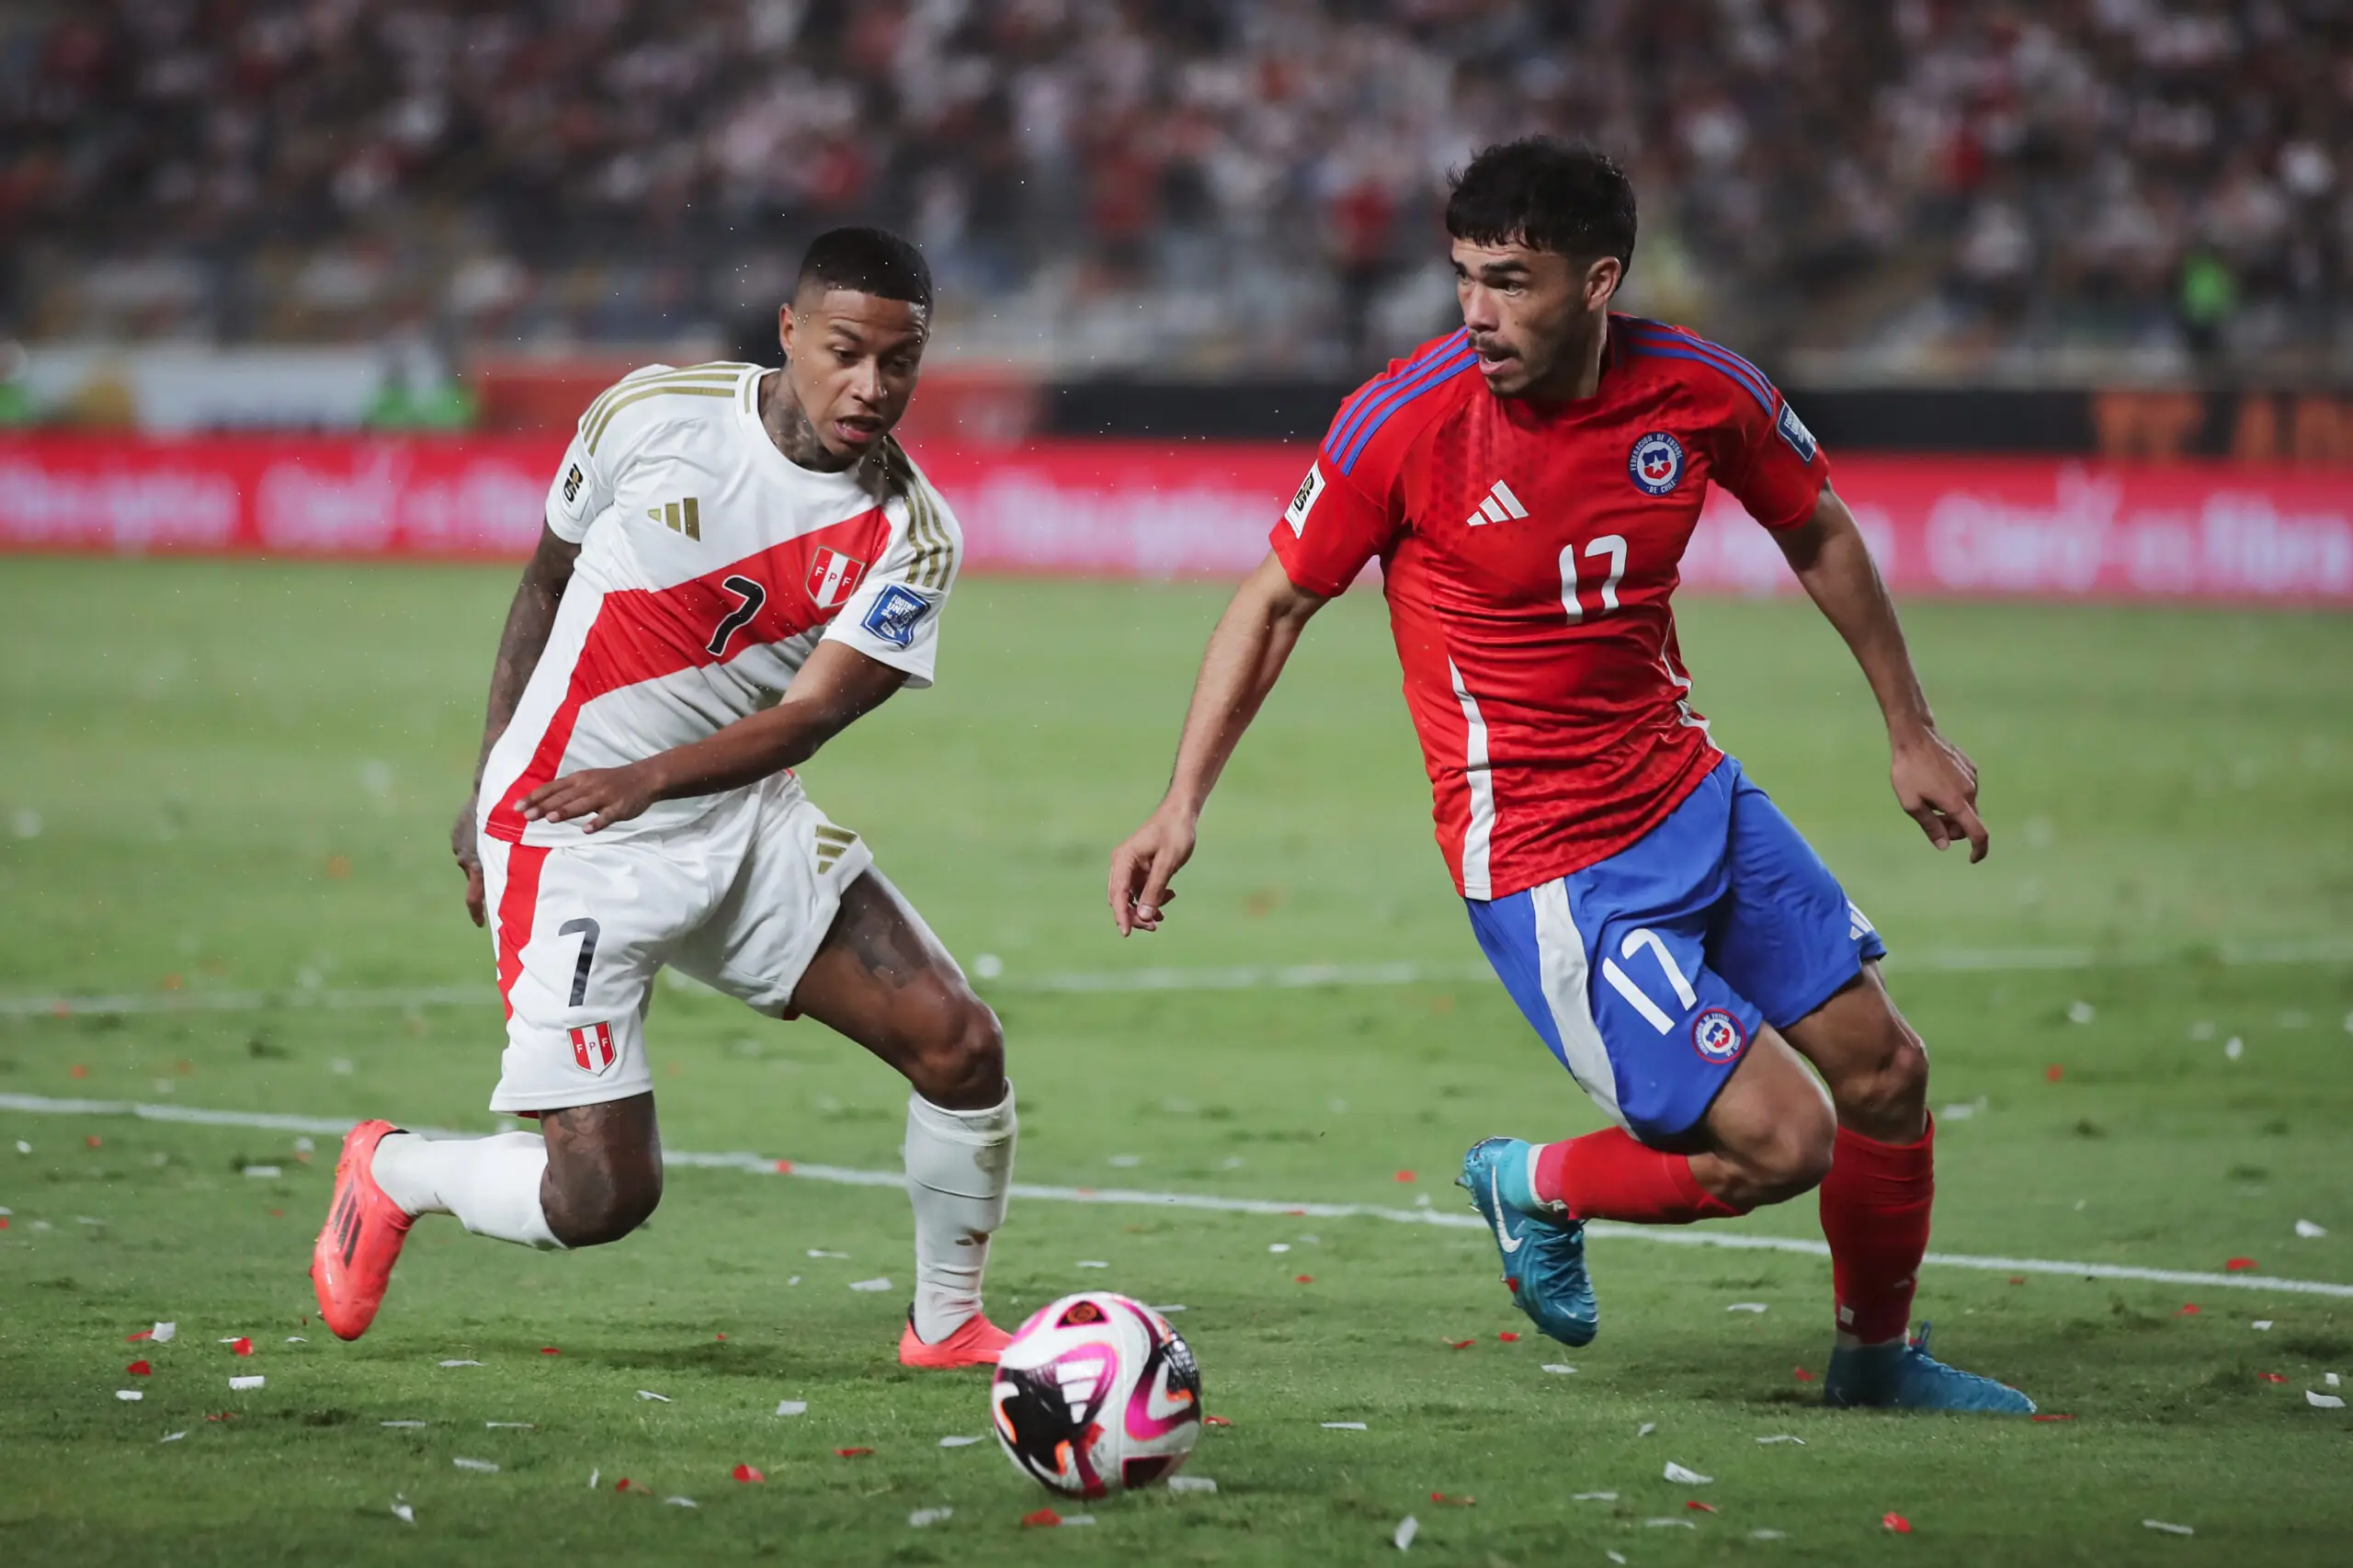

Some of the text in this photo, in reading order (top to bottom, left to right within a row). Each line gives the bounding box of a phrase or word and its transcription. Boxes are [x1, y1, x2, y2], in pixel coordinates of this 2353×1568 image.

[705, 574, 767, 657] 7
[1558, 534, 1628, 626] 17
[558, 917, 601, 1007] 7
[1602, 927, 1698, 1036] 17
